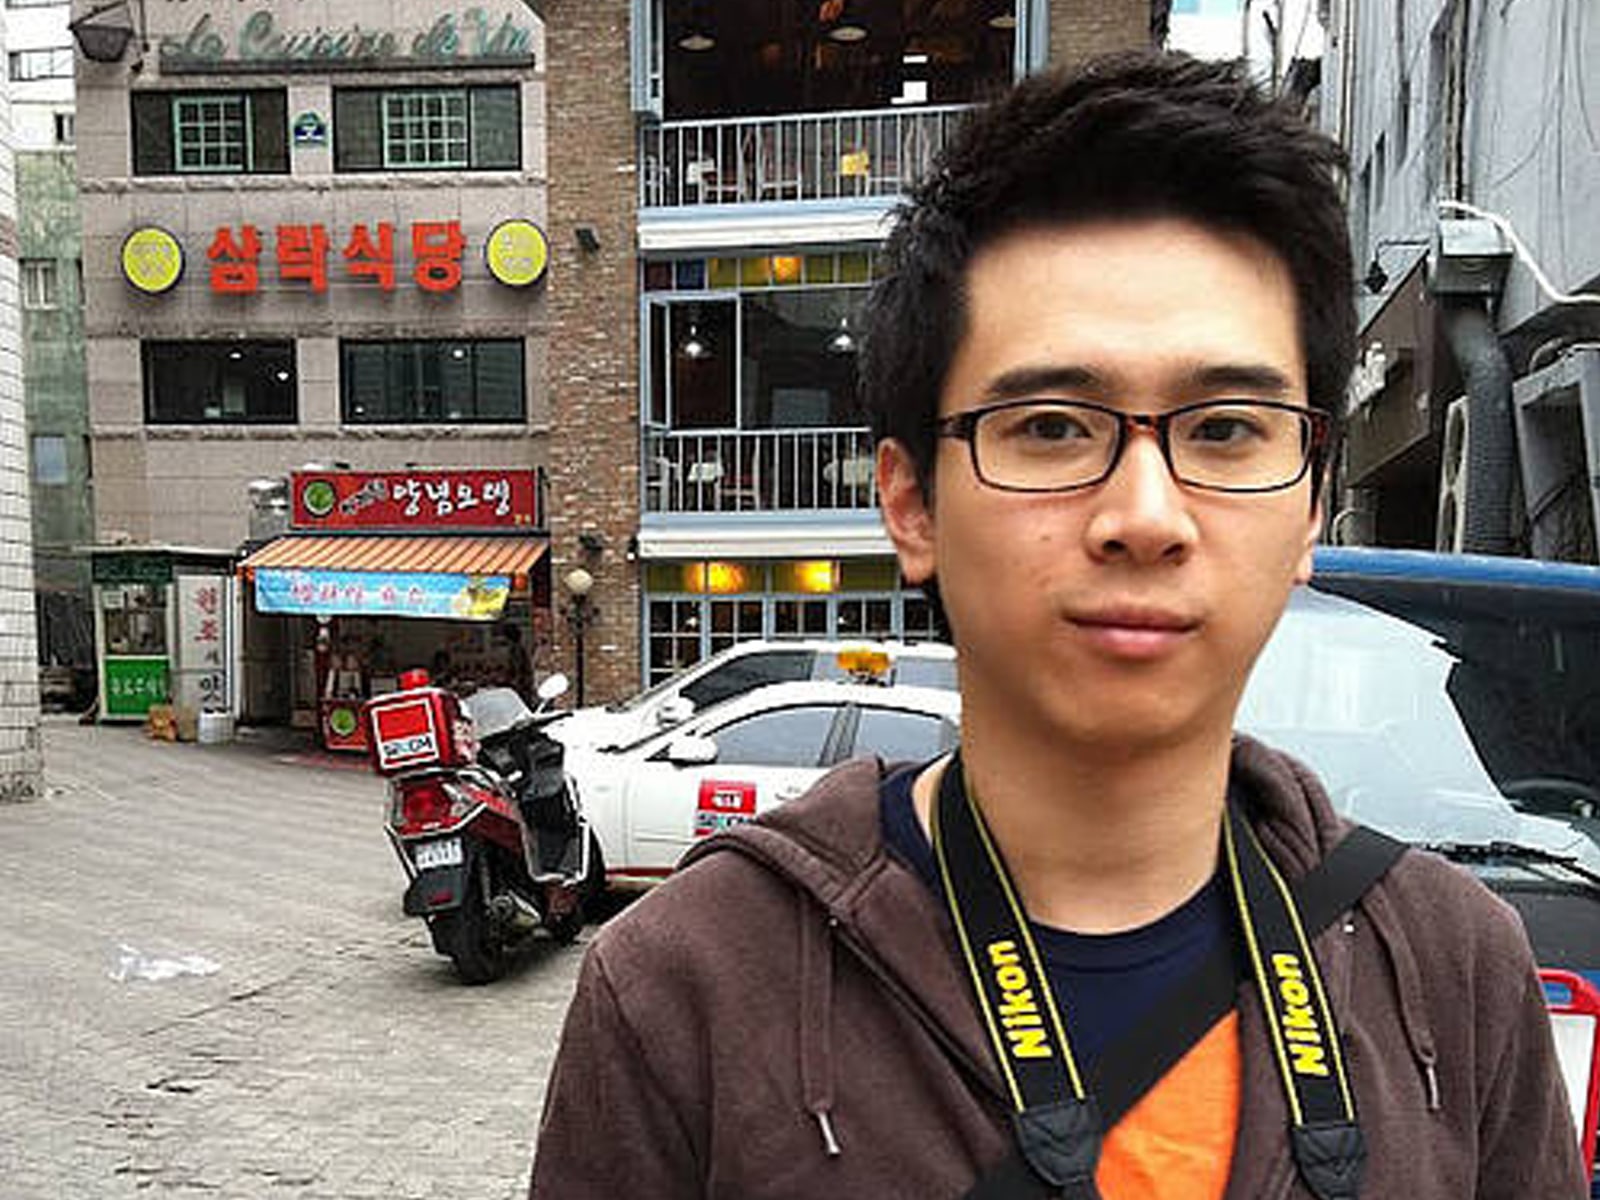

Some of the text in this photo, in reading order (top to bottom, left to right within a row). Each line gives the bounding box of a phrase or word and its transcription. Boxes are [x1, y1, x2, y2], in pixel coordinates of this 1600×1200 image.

[207, 222, 467, 293] 삼락식당
[987, 940, 1053, 1058] Nikon
[1271, 953, 1329, 1076] Nikon
